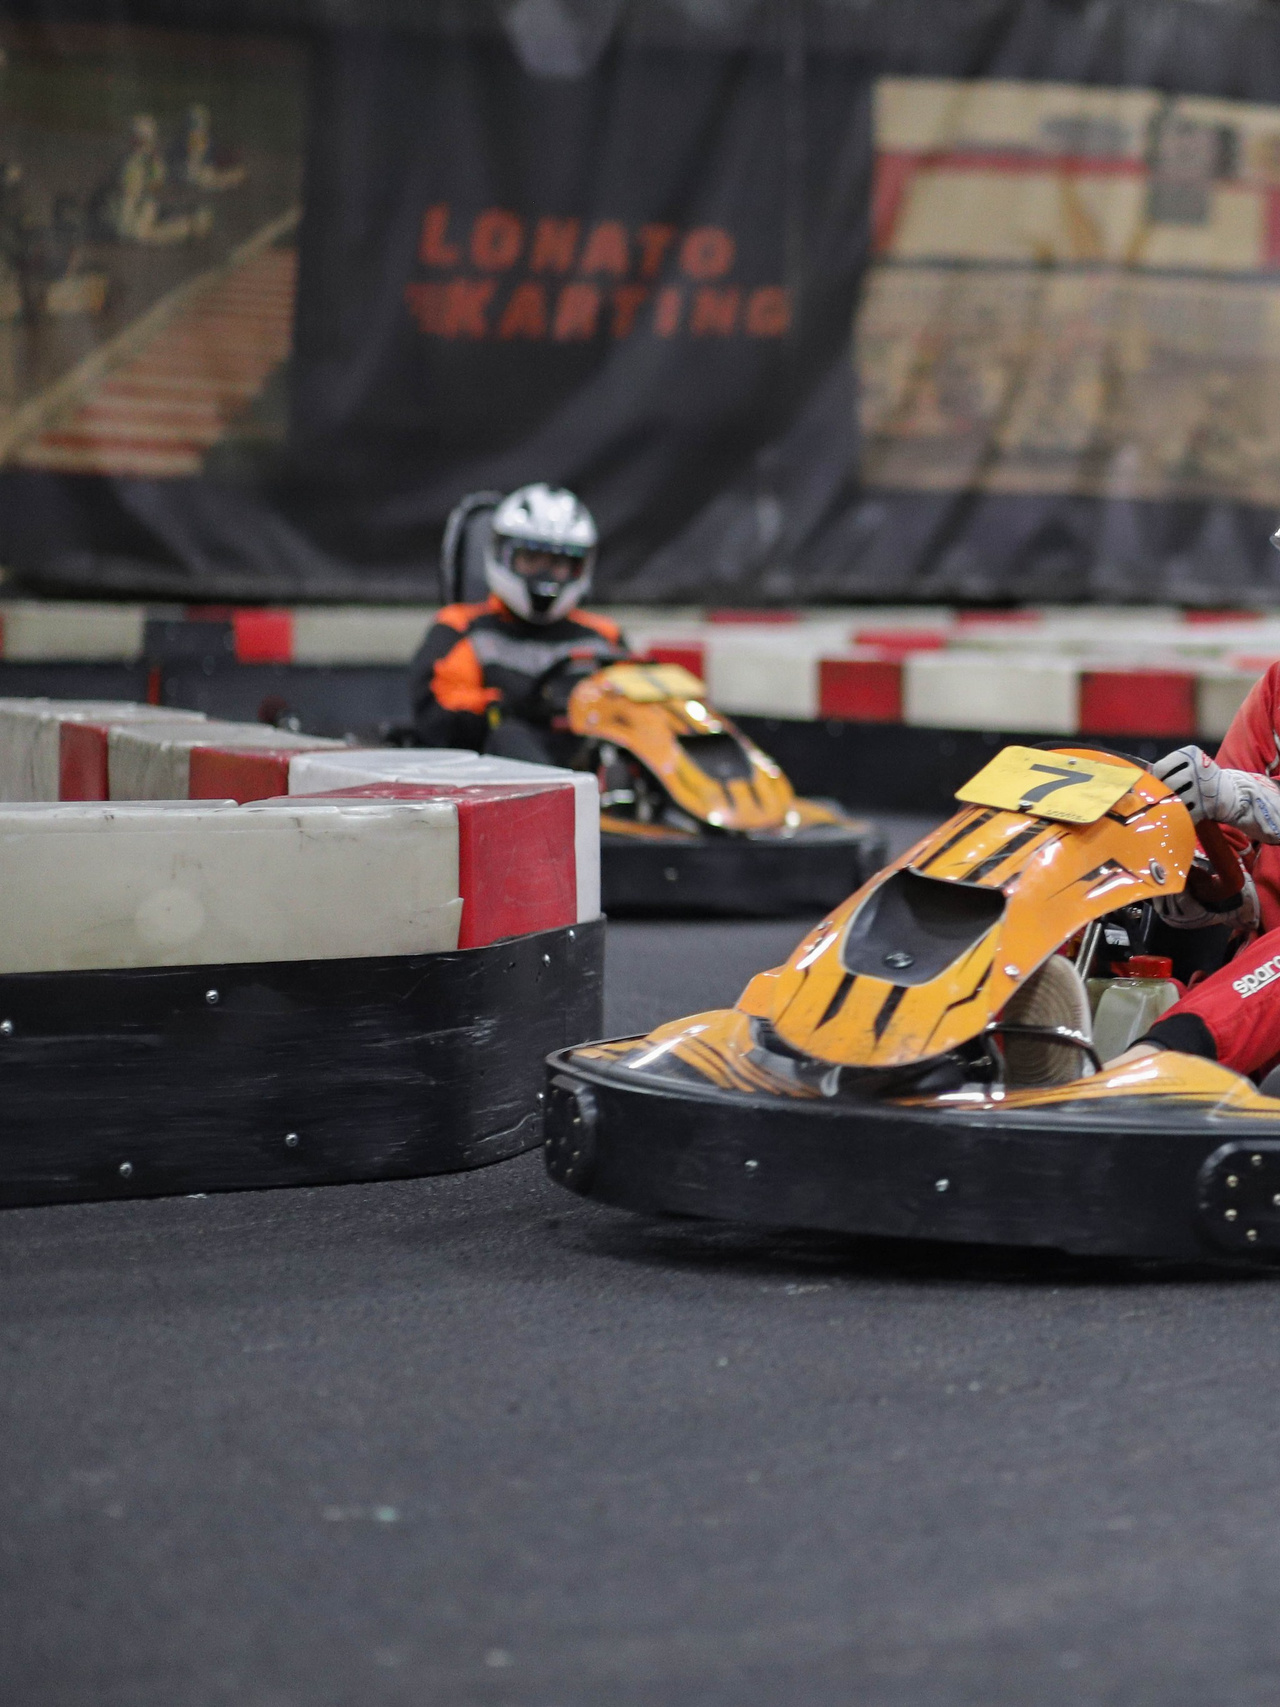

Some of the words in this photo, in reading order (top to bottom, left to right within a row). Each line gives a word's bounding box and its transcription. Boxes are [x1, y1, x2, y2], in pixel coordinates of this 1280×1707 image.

[419, 203, 736, 279] LONATO
[425, 276, 790, 342] KARTING
[1019, 763, 1094, 803] 7
